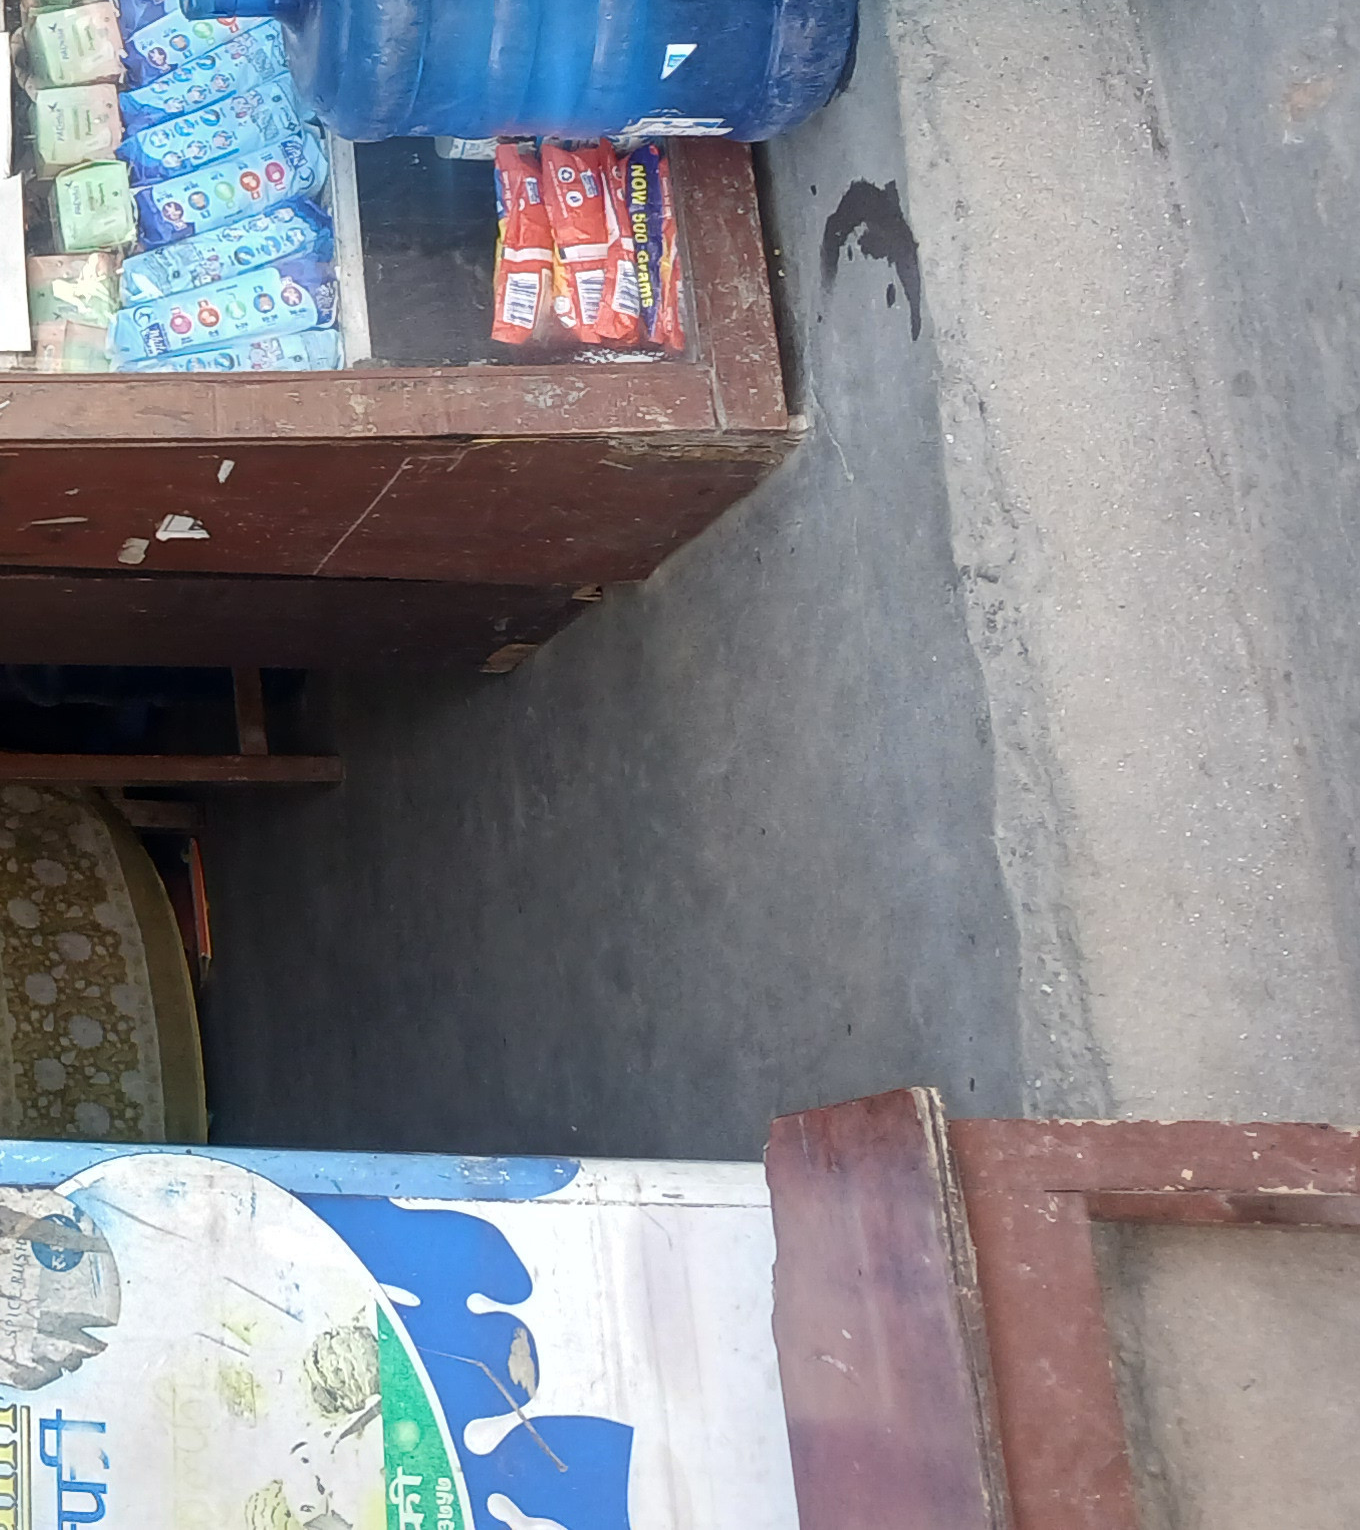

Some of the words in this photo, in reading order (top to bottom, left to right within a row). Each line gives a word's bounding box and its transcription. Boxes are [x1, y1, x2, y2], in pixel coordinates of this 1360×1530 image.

[630, 164, 648, 205] NOW
[634, 213, 648, 243] 500
[636, 250, 654, 308] Grams
